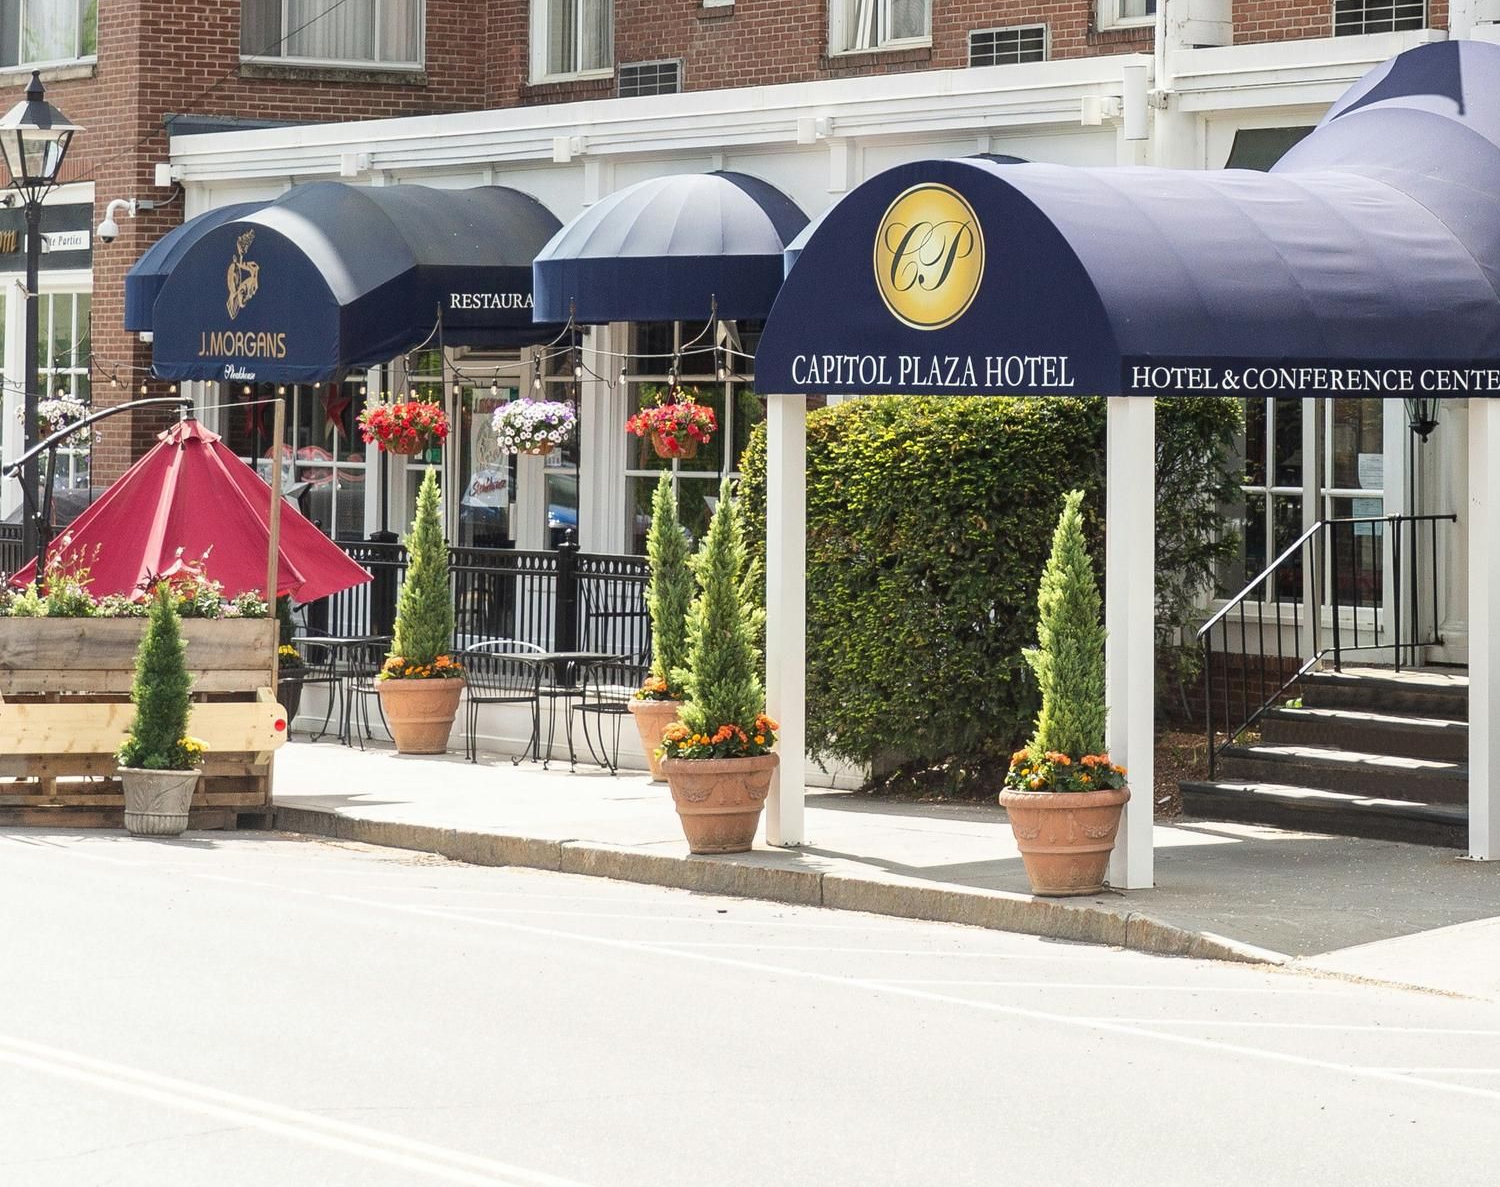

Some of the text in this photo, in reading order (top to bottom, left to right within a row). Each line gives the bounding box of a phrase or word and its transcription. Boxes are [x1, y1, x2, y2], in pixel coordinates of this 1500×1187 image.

[198, 330, 287, 359] J.MORGANS
[791, 353, 1076, 388] CAPITOL PLAZA HOTEL
[1131, 366, 1219, 390] HOTEL
[1242, 367, 1414, 392] CONFERENCE
